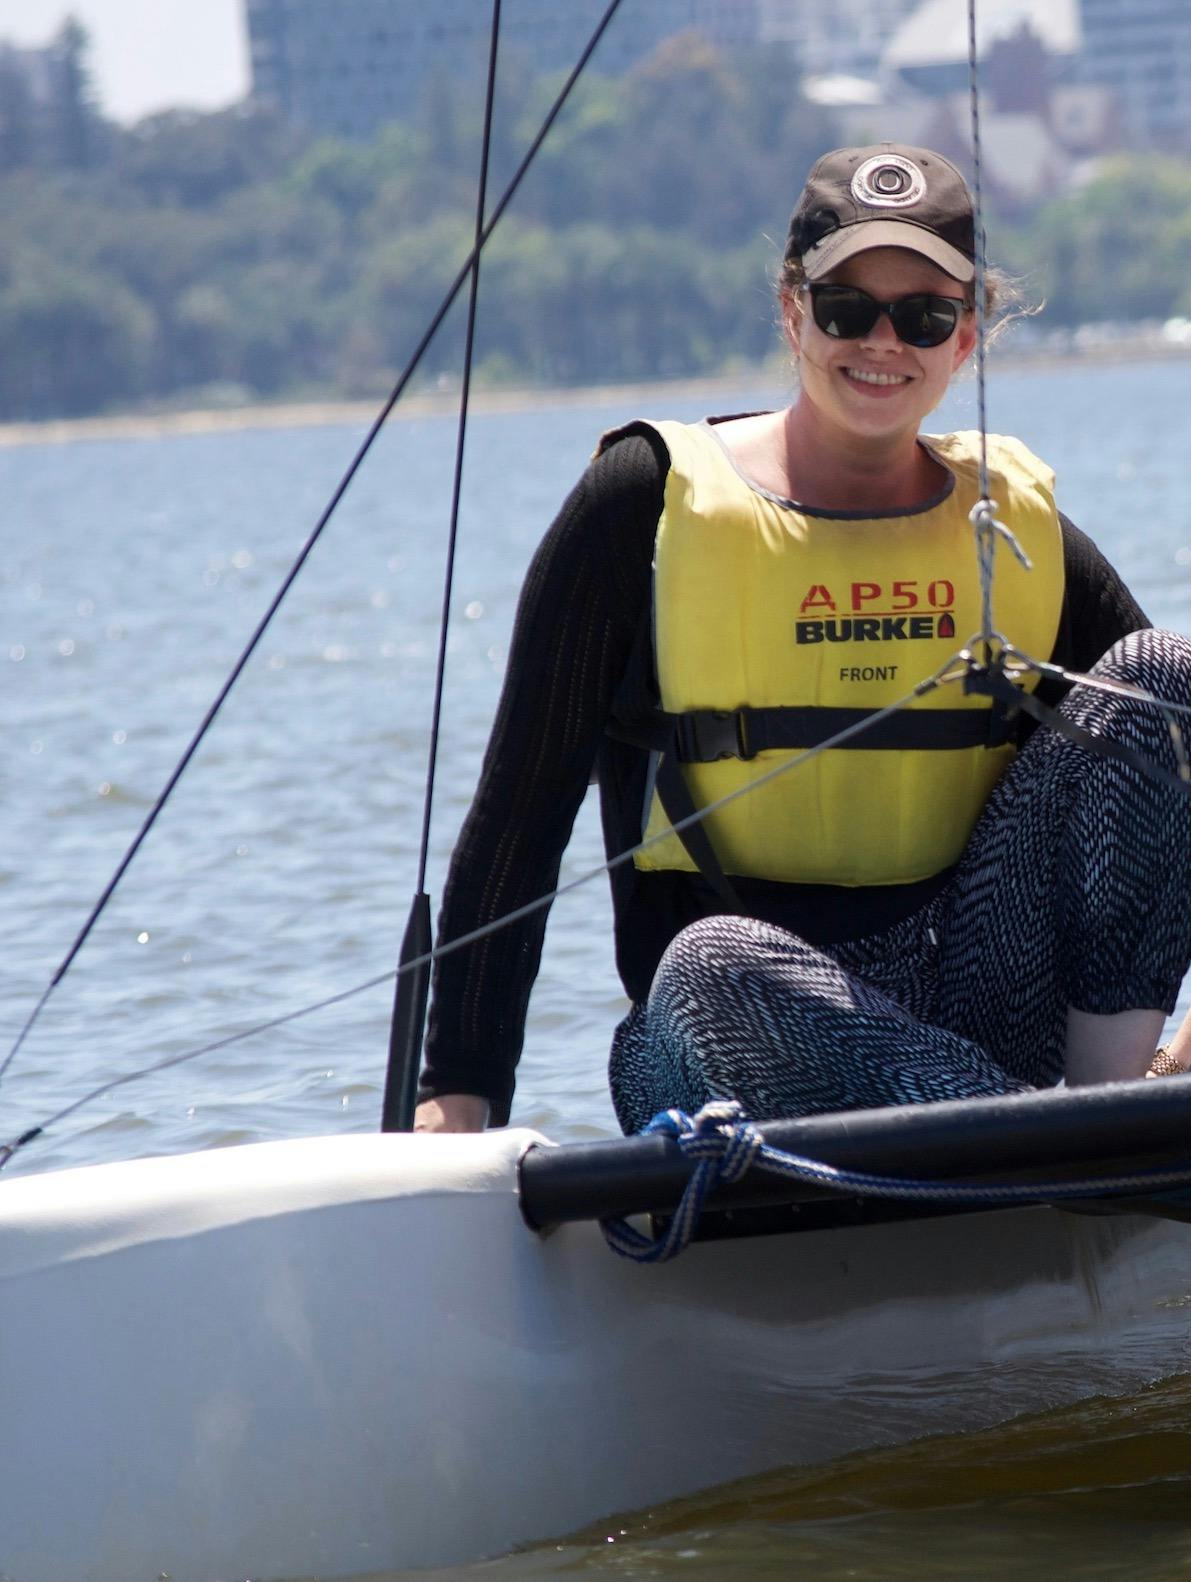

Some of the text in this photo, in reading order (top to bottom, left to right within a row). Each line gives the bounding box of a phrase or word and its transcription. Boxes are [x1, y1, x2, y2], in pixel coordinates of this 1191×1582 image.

[800, 580, 955, 613] AP50
[796, 616, 933, 644] BURKE
[839, 666, 898, 681] FRONT
